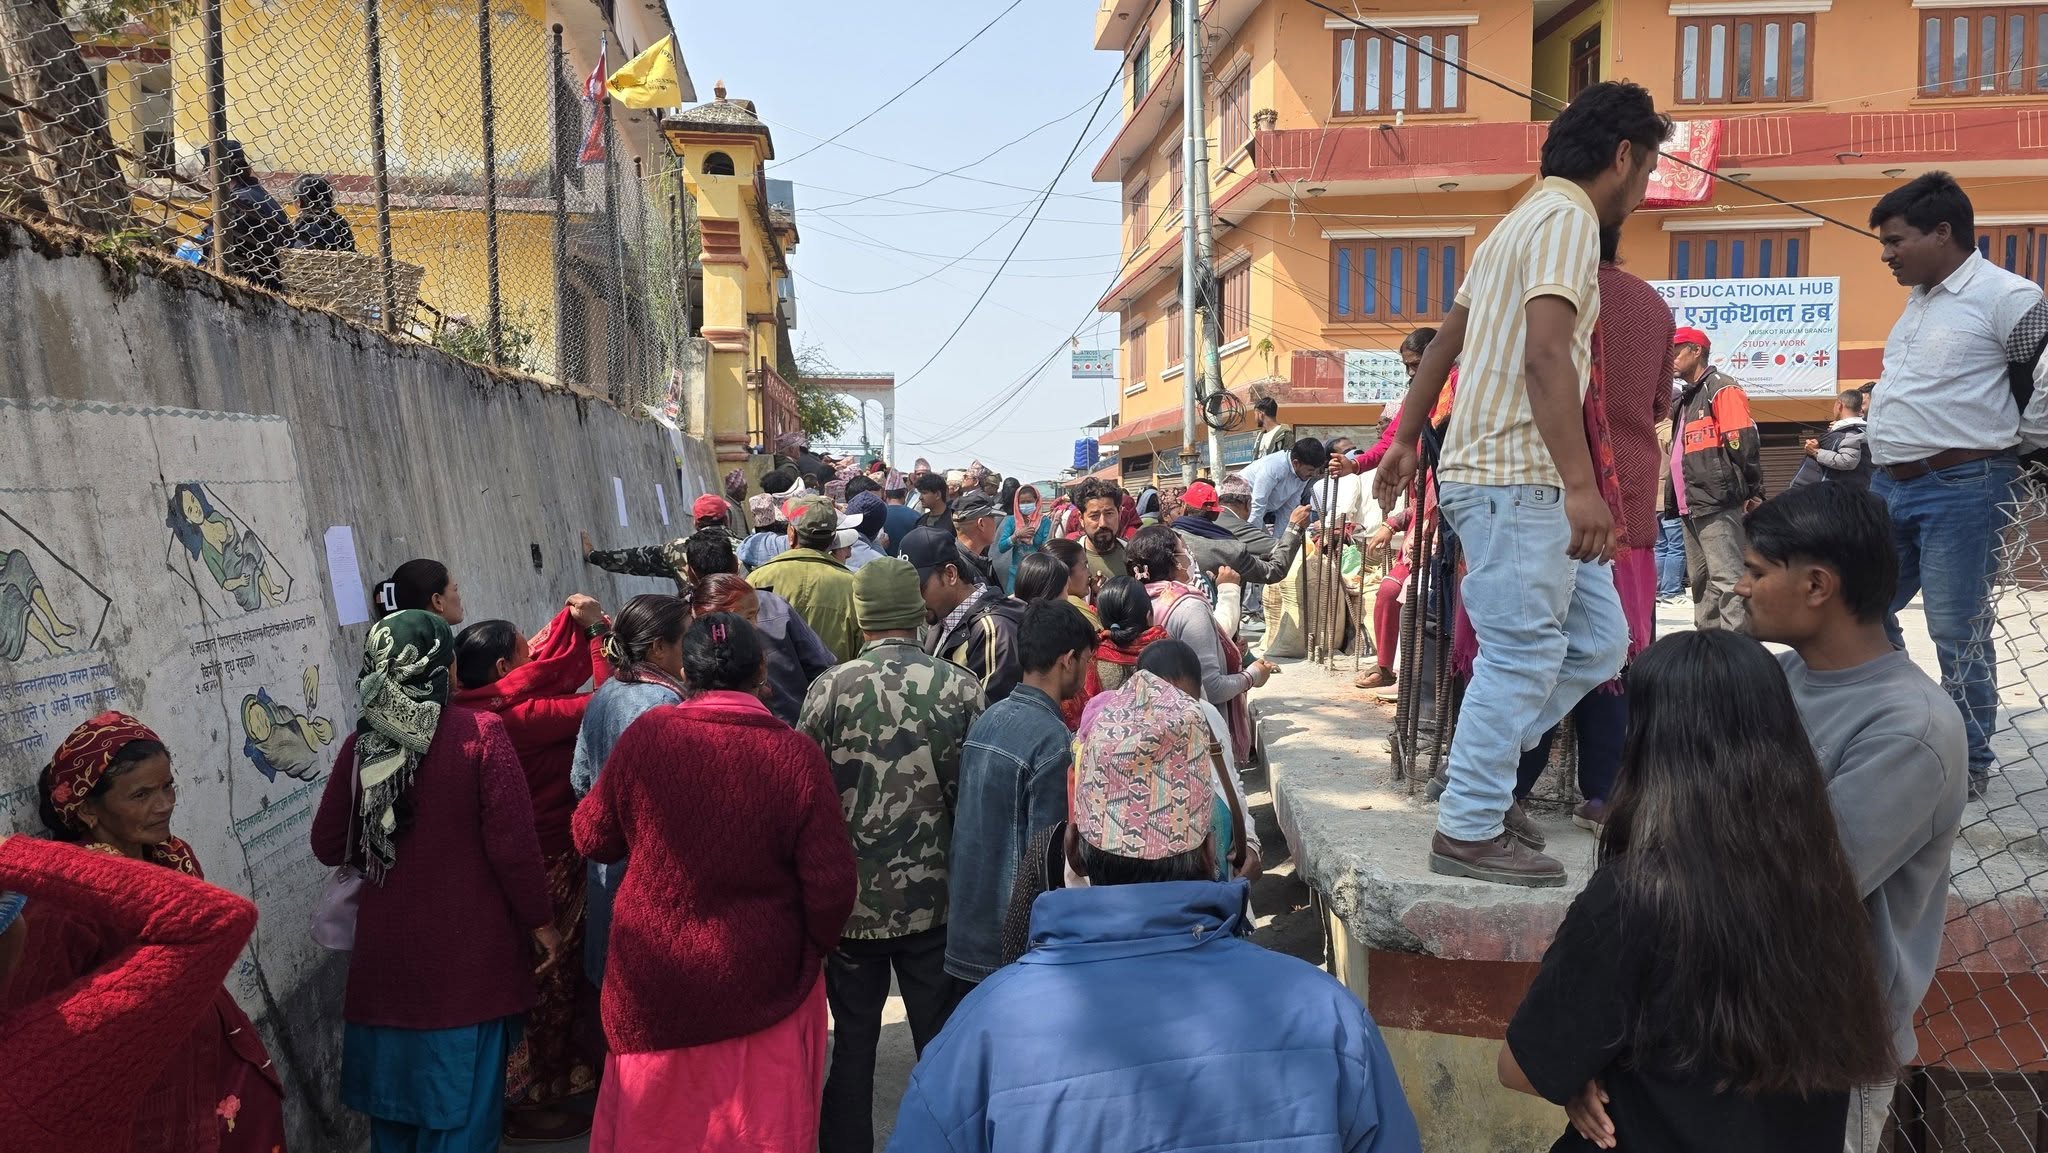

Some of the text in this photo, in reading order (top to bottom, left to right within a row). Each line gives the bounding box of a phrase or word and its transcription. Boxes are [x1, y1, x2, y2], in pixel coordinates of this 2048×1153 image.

[1680, 283, 1795, 298] EDUCATIONAL
[1800, 282, 1833, 295] HUB
[1684, 302, 1796, 330] एजुकेशनल
[1801, 303, 1833, 323] हब
[1742, 340, 1770, 348] STUDY
[1779, 339, 1806, 347] WORK
